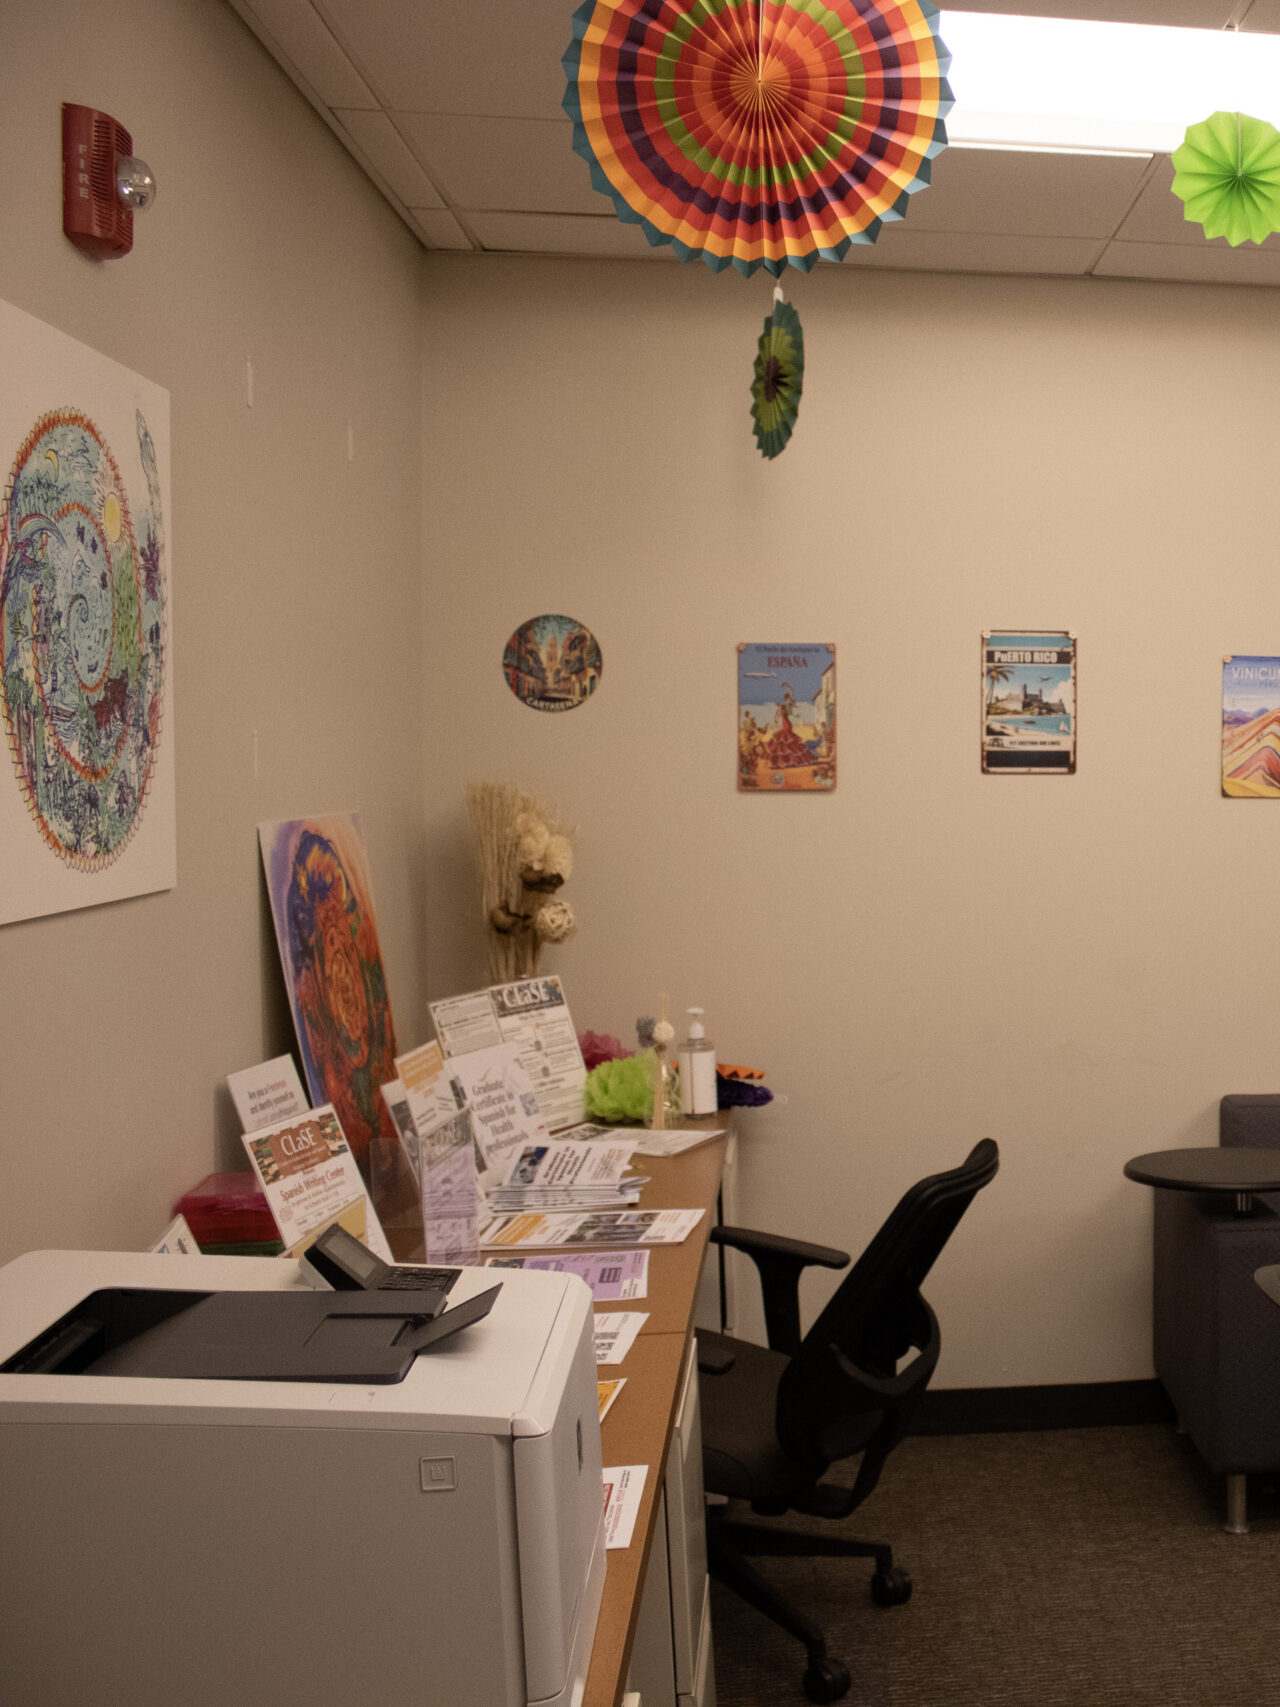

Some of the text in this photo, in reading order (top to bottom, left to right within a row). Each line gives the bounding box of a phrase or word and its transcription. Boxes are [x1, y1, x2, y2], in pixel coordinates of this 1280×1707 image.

[78, 143, 90, 199] FIRE
[767, 655, 808, 668] ESPAÑA
[1033, 651, 1058, 663] RICO
[502, 980, 549, 1008] CLaSE
[472, 1081, 504, 1097] Graduate
[470, 1092, 515, 1112] Certificate in
[478, 1105, 516, 1127] Spanish for
[490, 1120, 515, 1136] Health
[280, 1126, 318, 1156] CLaSE
[280, 1181, 305, 1204] Spanish
[303, 1174, 327, 1191] Writing
[325, 1167, 345, 1181] Center
